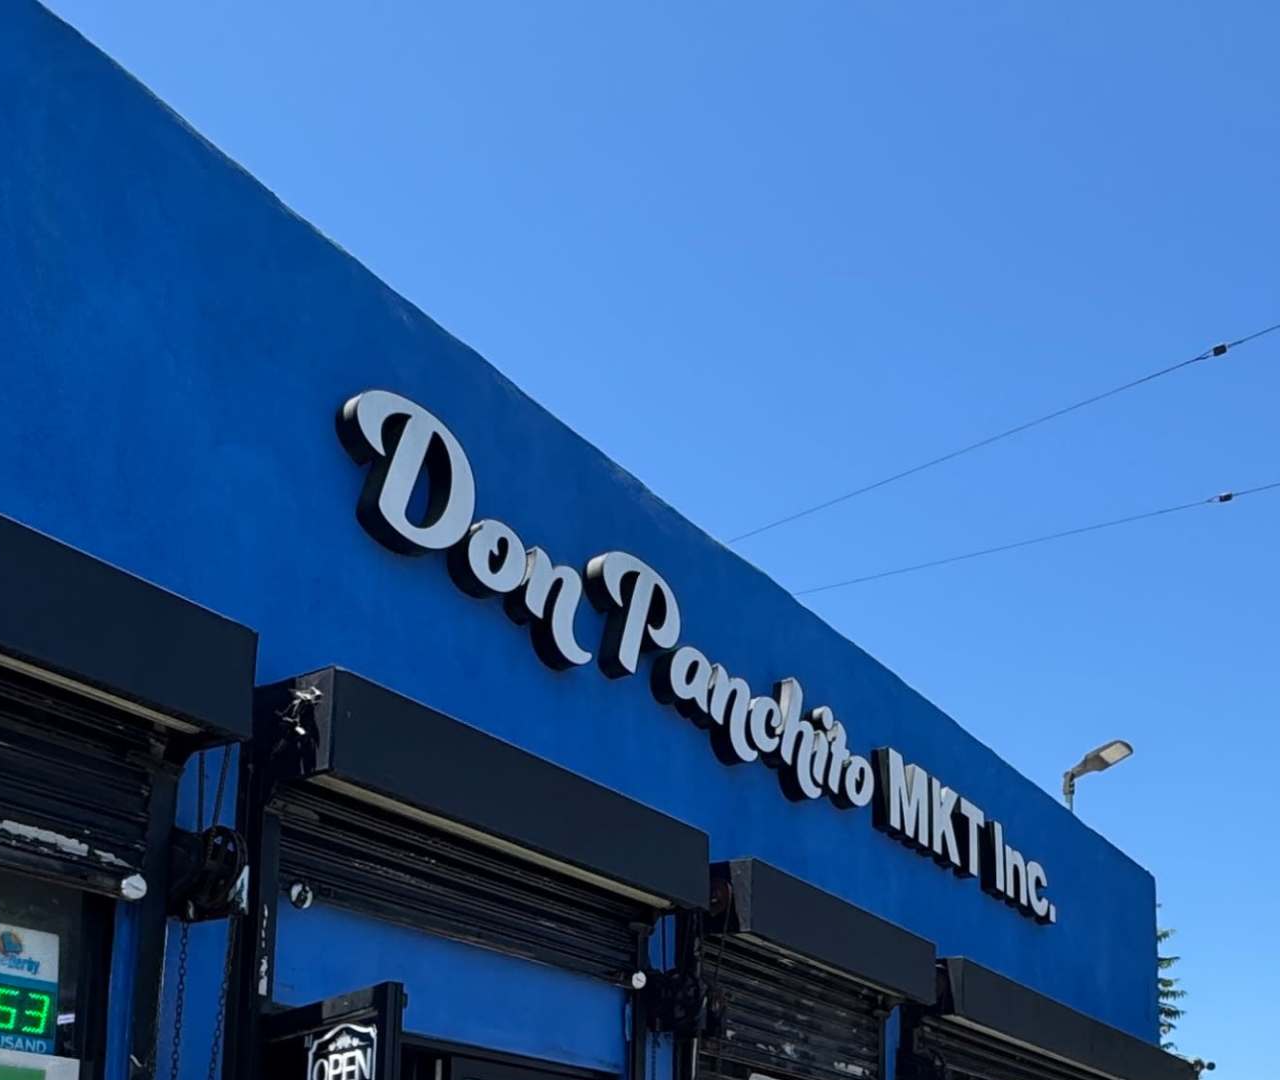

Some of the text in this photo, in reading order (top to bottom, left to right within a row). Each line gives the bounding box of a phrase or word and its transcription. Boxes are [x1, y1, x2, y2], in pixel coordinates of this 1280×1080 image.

[336, 388, 1057, 925] Don Panchito MKT Inc.
